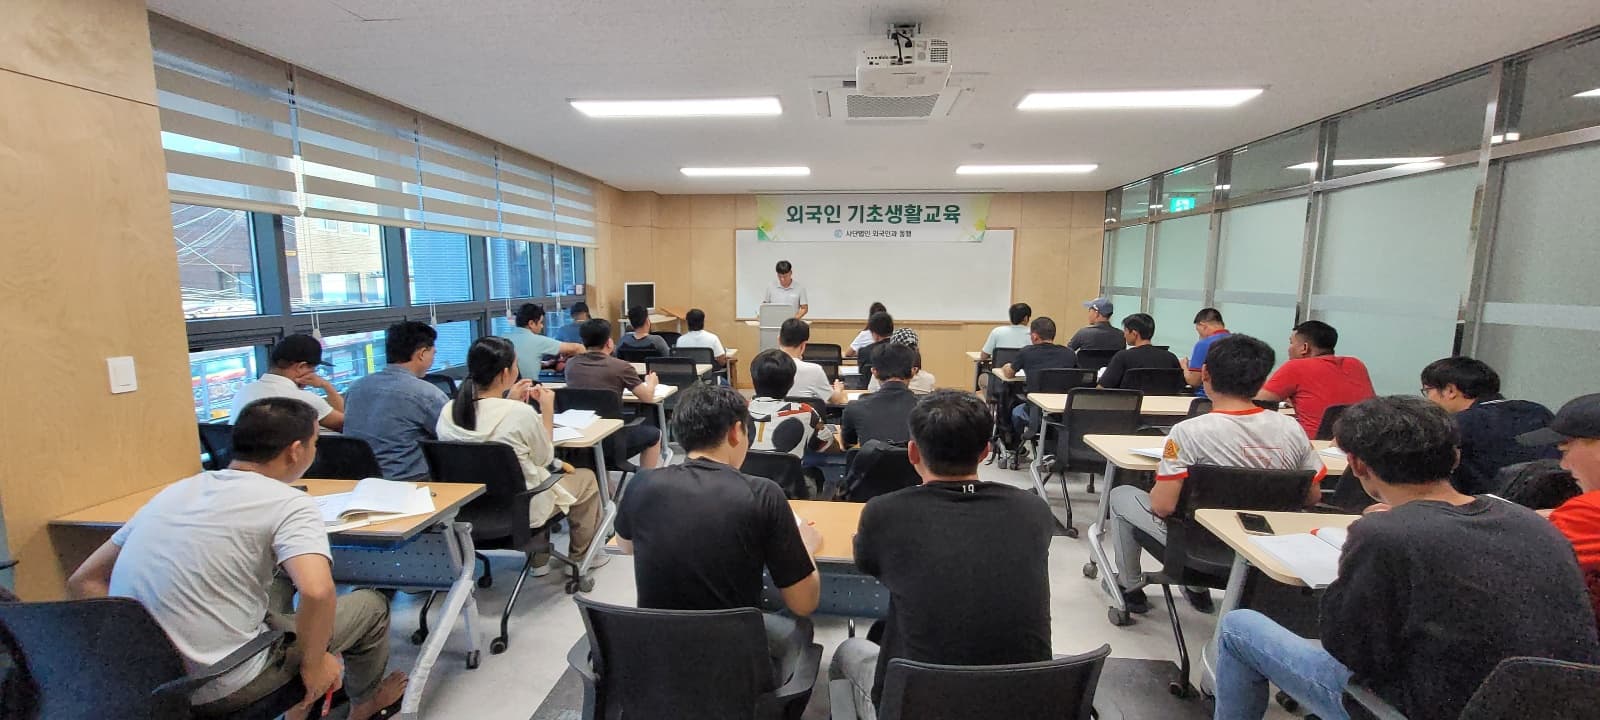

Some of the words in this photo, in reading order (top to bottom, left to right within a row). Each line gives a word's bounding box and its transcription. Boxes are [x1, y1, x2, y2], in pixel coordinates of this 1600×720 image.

[786, 205, 841, 224] 외국인
[847, 204, 961, 224] 기초생활교육
[846, 230, 871, 238] 사단법인
[872, 230, 897, 238] 외국인과
[962, 484, 975, 494] 19
